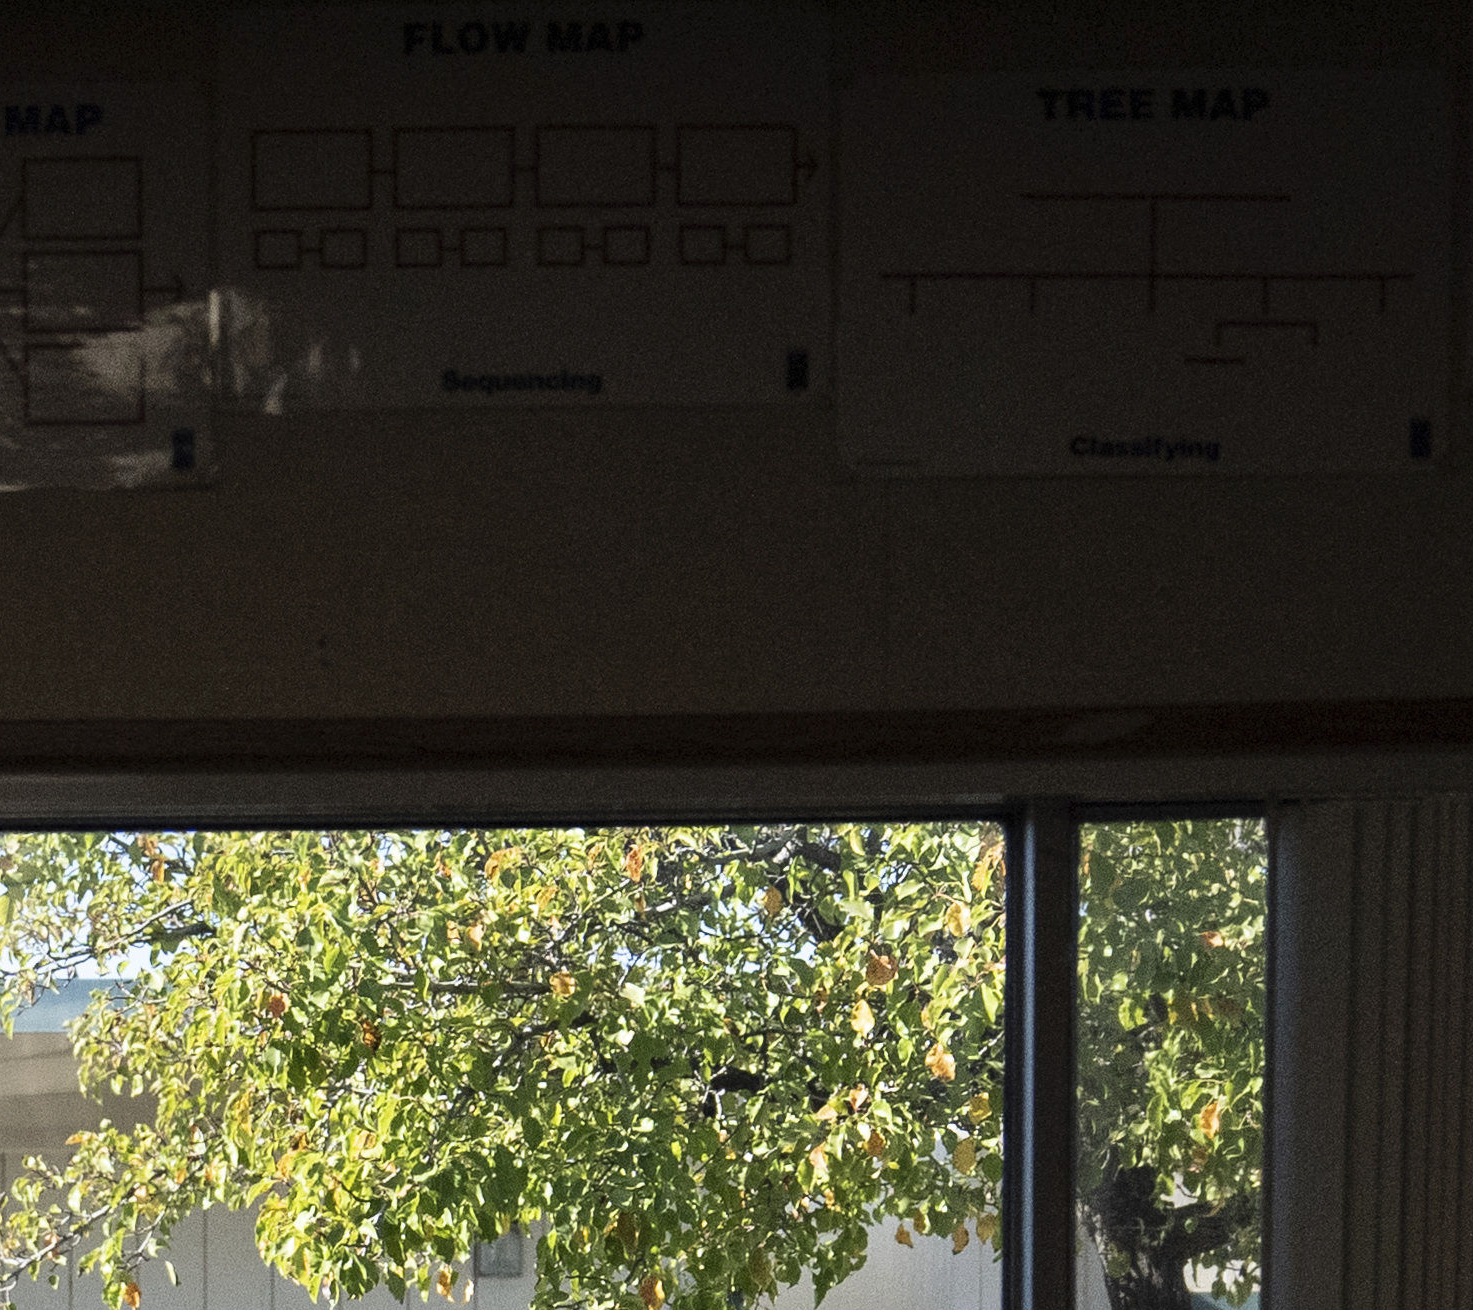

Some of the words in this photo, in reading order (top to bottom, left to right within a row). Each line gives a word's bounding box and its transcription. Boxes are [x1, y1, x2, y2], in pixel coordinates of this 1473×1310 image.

[403, 20, 530, 55] FLOW
[546, 20, 644, 52] MAP
[5, 104, 102, 136] MAP
[1036, 88, 1154, 120] TREE
[1171, 88, 1269, 120] MAP
[442, 369, 603, 395] Sequencing
[1069, 436, 1221, 462] Classifying
